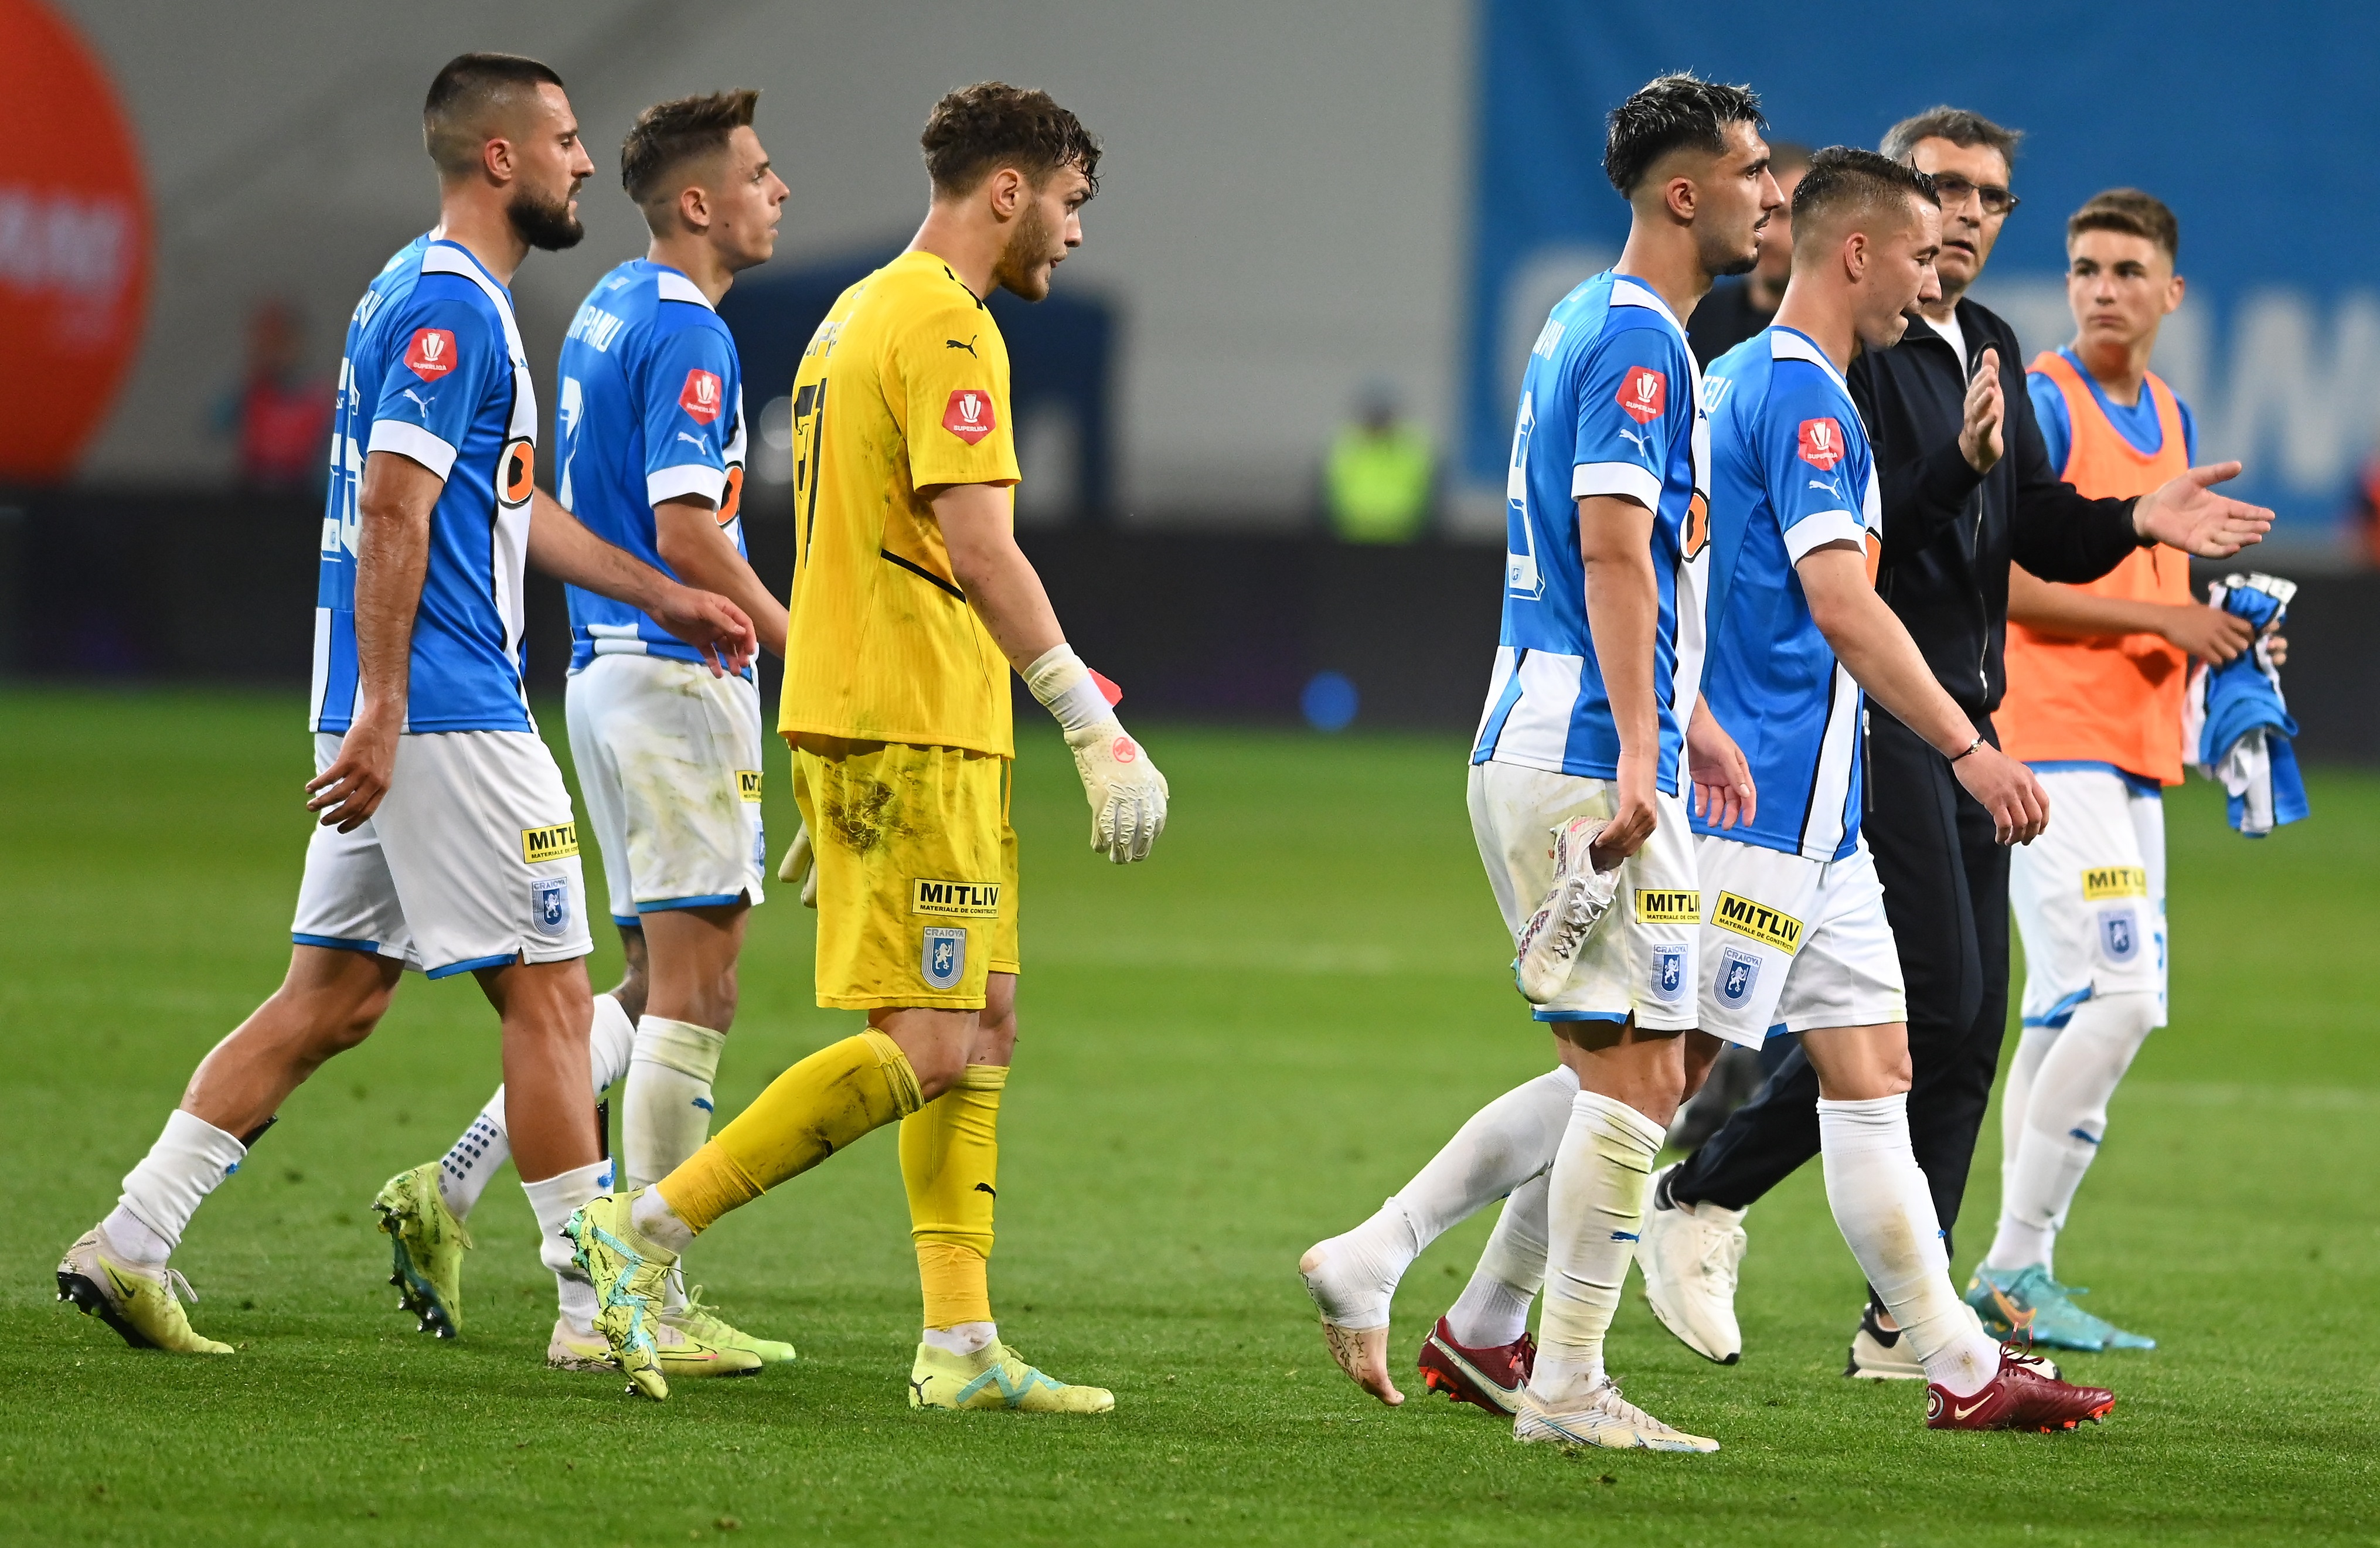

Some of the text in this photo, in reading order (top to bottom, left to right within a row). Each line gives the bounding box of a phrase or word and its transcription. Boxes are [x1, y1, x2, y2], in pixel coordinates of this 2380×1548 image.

[413, 362, 447, 371] SUPERLIGA
[1626, 400, 1657, 414] SUPERLIGA
[531, 849, 563, 859] MATERIALE
[534, 879, 566, 890] CRAIOVA
[920, 883, 999, 906] MITLIV
[920, 904, 958, 913] MATERIALE
[1721, 897, 1800, 942] MITLIV
[925, 928, 964, 937] CRAIOVA
[1719, 918, 1756, 935] MATERIALE
[1727, 950, 1759, 966] CRAIOVA
